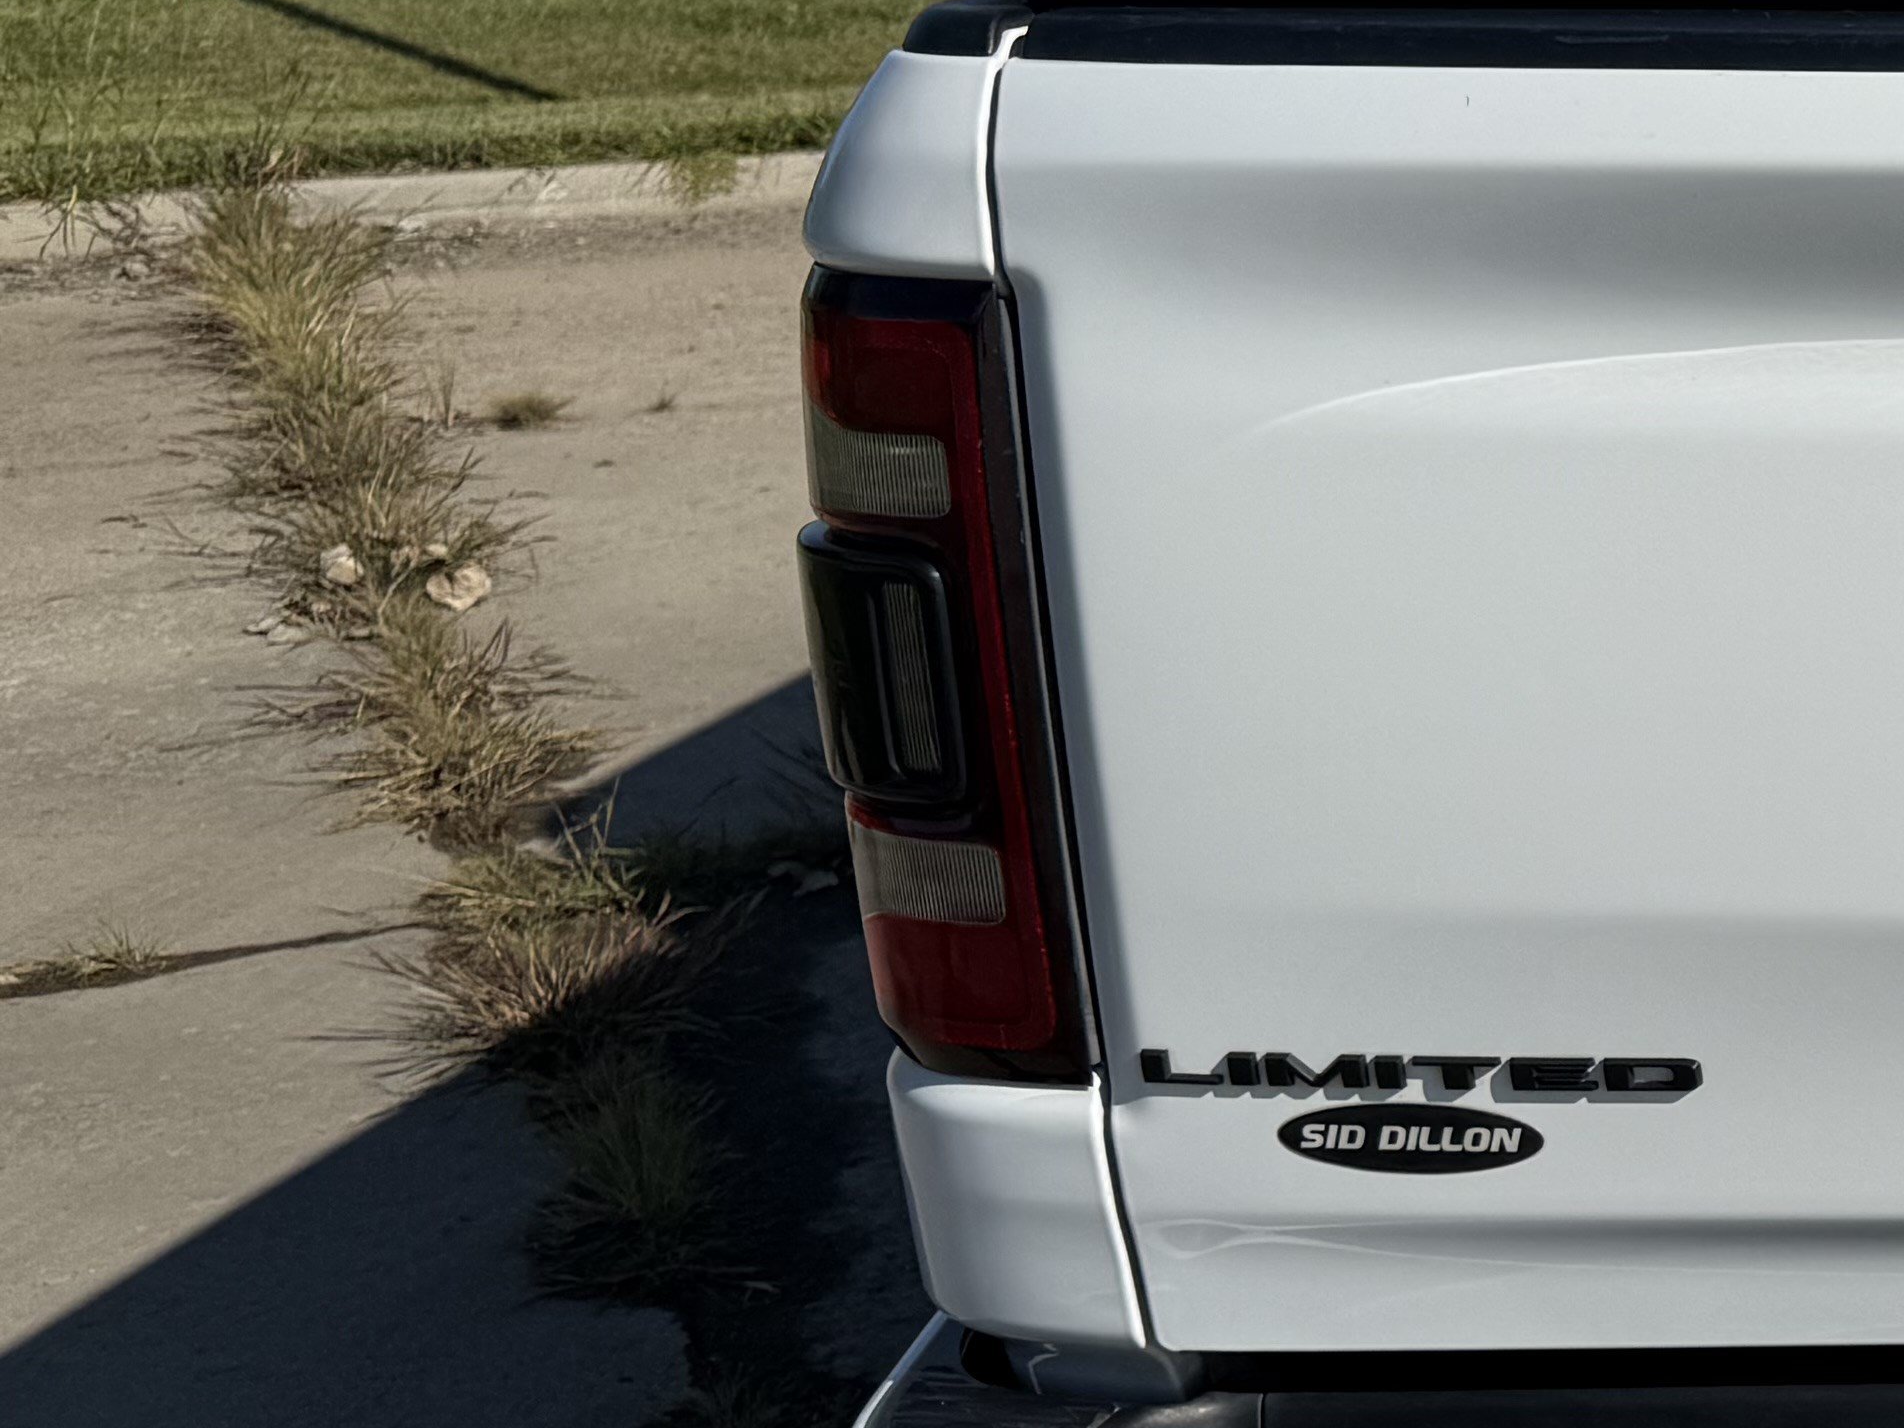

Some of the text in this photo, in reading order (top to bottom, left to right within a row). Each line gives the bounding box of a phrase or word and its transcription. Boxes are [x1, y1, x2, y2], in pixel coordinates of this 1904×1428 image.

[1139, 1048, 1704, 1092] LIMITED
[1300, 1123, 1522, 1153] SID DILLON
